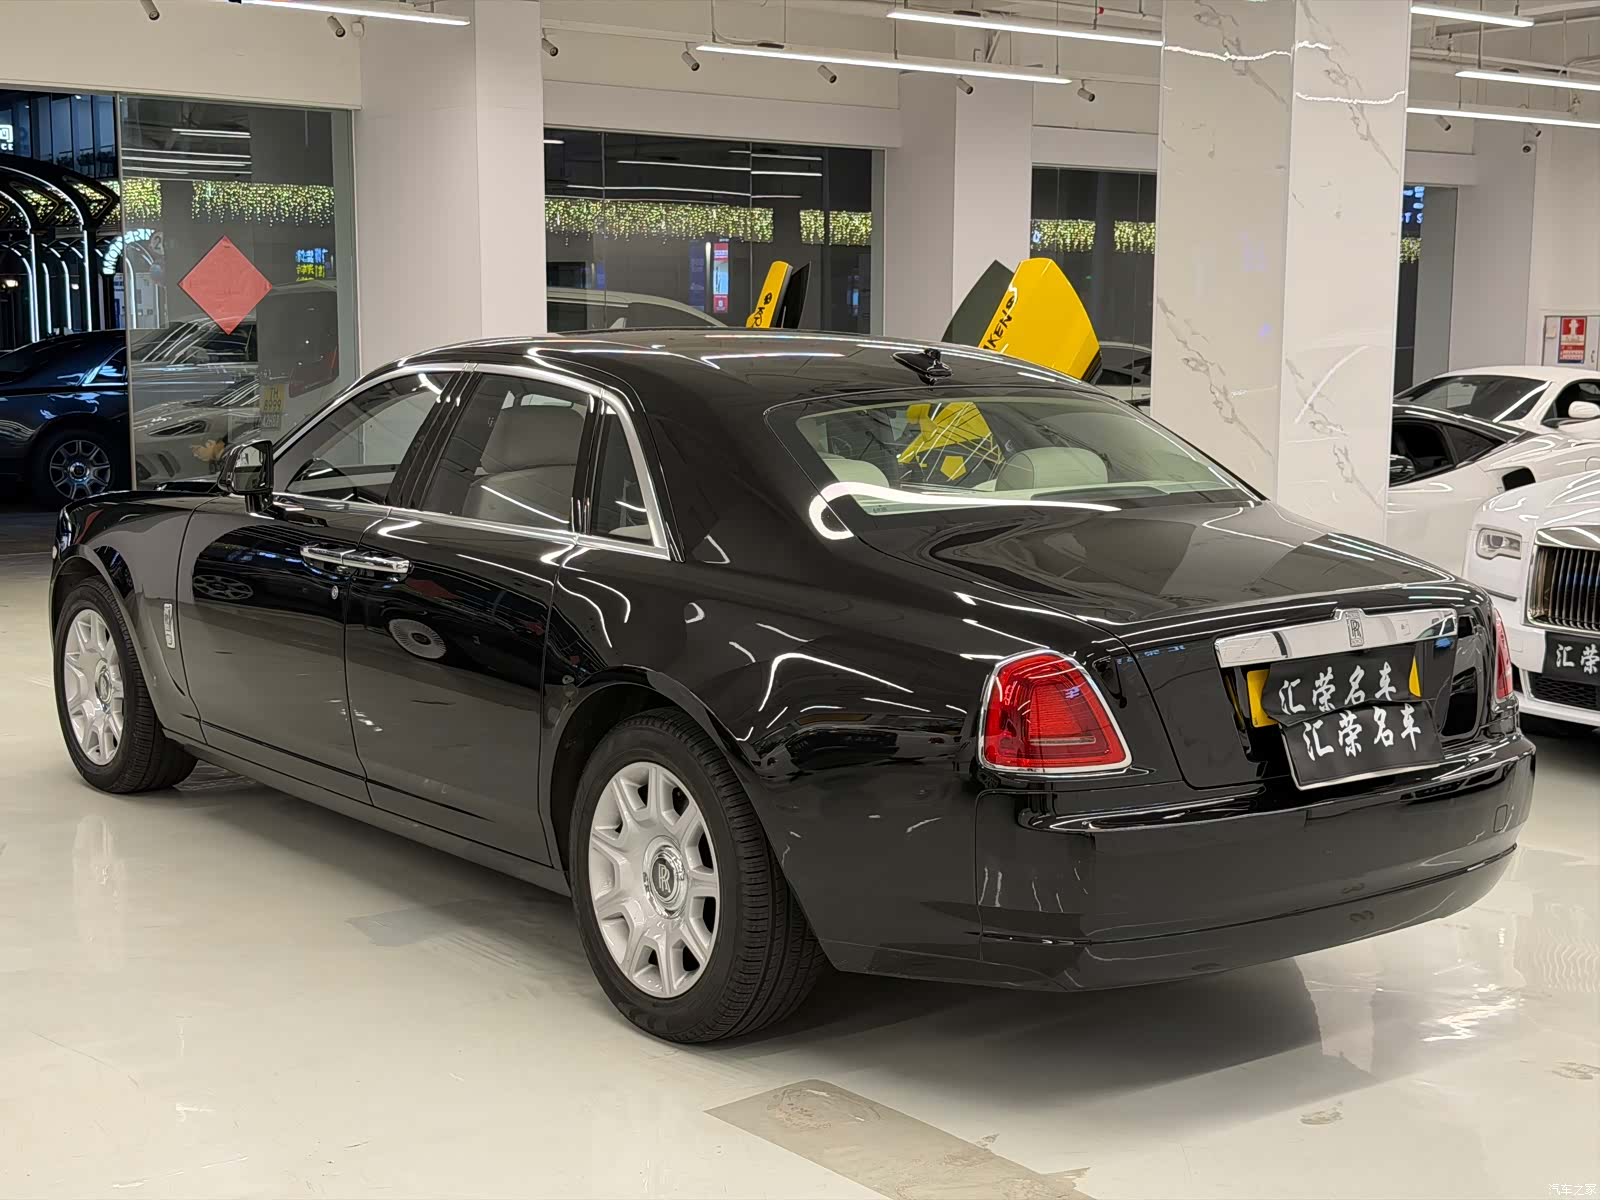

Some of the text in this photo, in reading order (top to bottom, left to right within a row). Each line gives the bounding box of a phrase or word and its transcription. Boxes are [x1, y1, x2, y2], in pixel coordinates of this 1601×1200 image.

[1278, 661, 1397, 716] 汇荣名车
[1302, 703, 1422, 761] 汇荣名车
